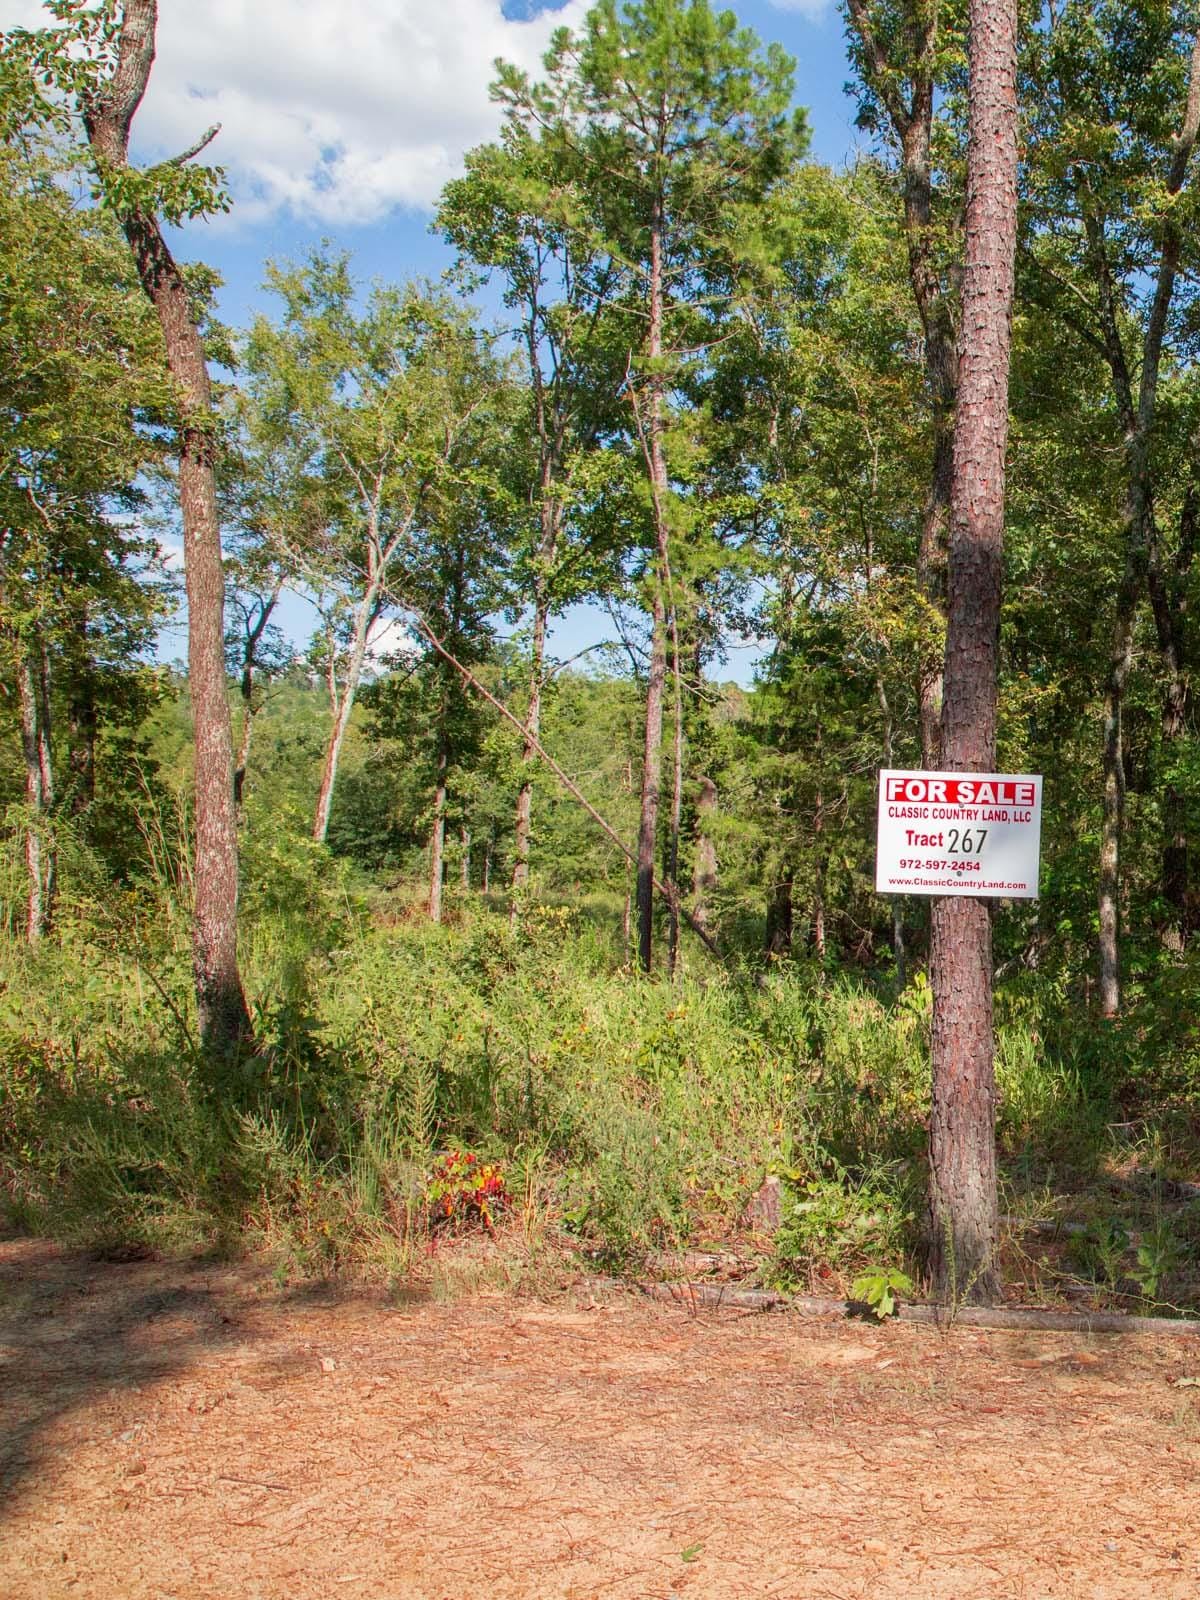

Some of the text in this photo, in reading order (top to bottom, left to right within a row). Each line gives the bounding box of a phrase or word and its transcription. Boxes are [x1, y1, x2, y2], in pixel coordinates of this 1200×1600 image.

[888, 780, 1033, 805] FOR SALE
[888, 806, 1031, 824] CLASSIC COUNTRY LAND, LLC
[905, 828, 988, 854] Tract 267
[899, 859, 981, 871] 972-597-2454
[888, 877, 1027, 890] www.ClassicCountryLand.com
